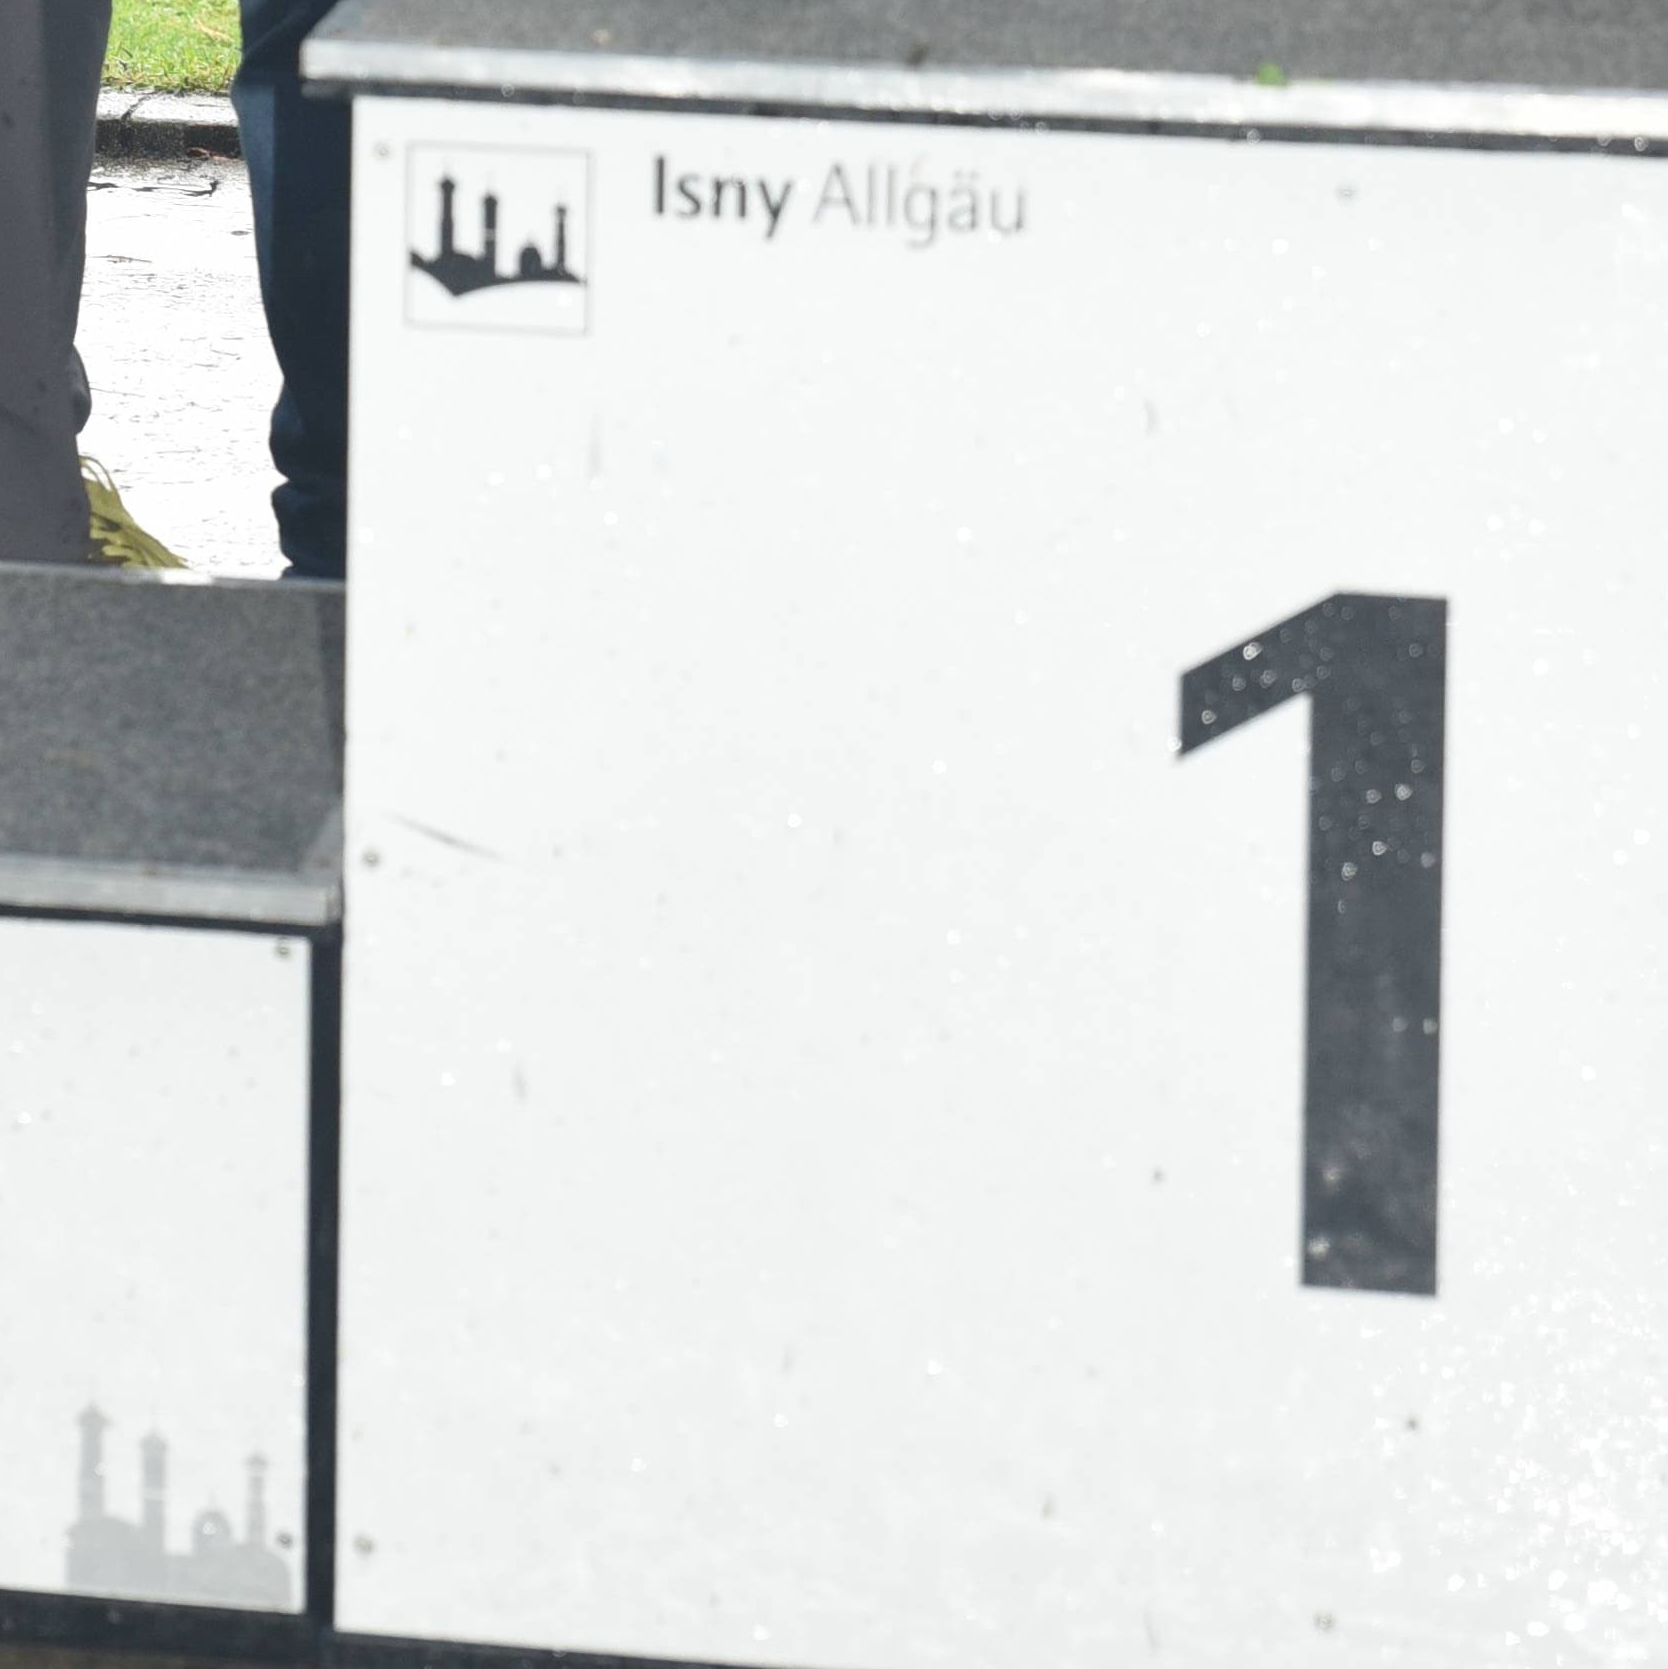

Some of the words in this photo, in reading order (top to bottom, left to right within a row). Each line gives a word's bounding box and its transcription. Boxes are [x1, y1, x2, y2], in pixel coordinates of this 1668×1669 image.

[652, 155, 794, 239] Isny
[812, 161, 1028, 248] Allgäu
[1175, 590, 1448, 1298] 1
